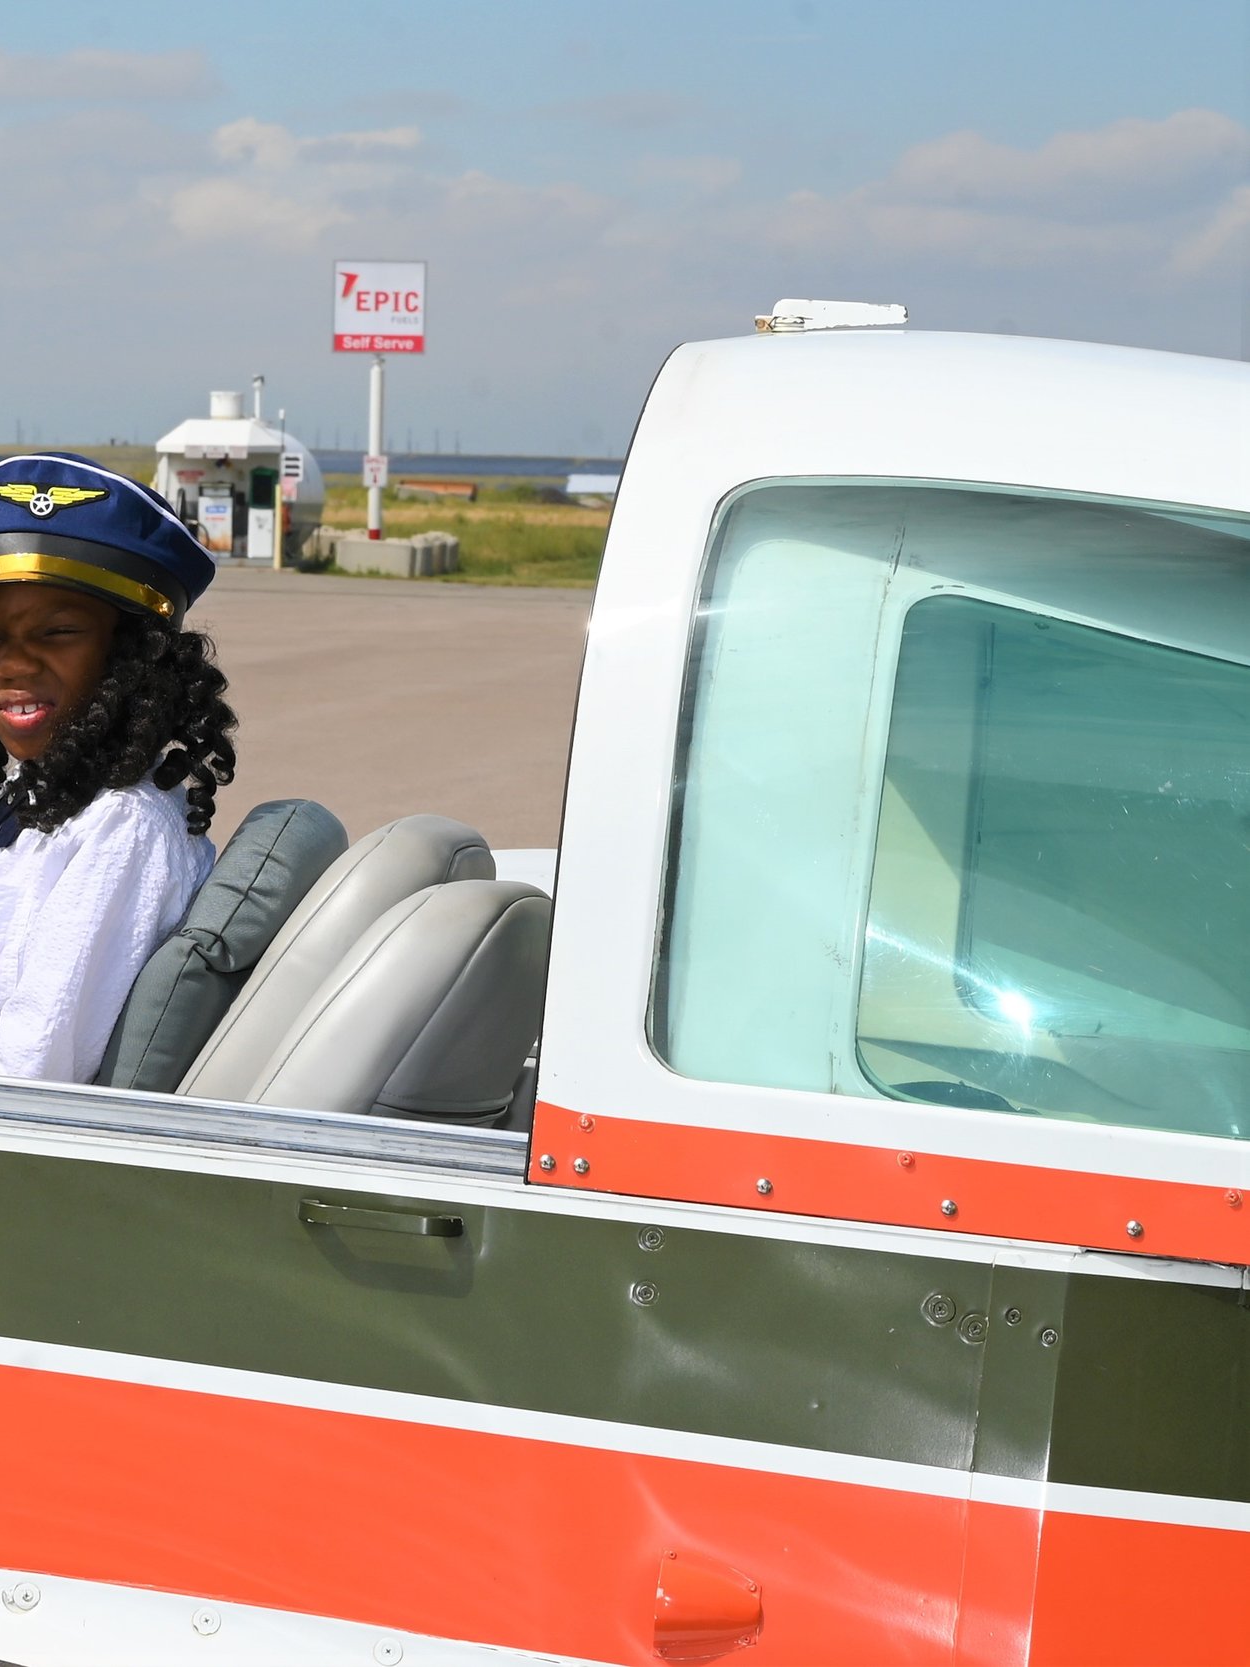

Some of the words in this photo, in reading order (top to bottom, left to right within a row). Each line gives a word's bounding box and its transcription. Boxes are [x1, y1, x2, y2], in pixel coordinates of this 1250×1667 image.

[356, 291, 419, 312] EPIC
[342, 336, 371, 349] Self
[373, 336, 414, 350] Serve
